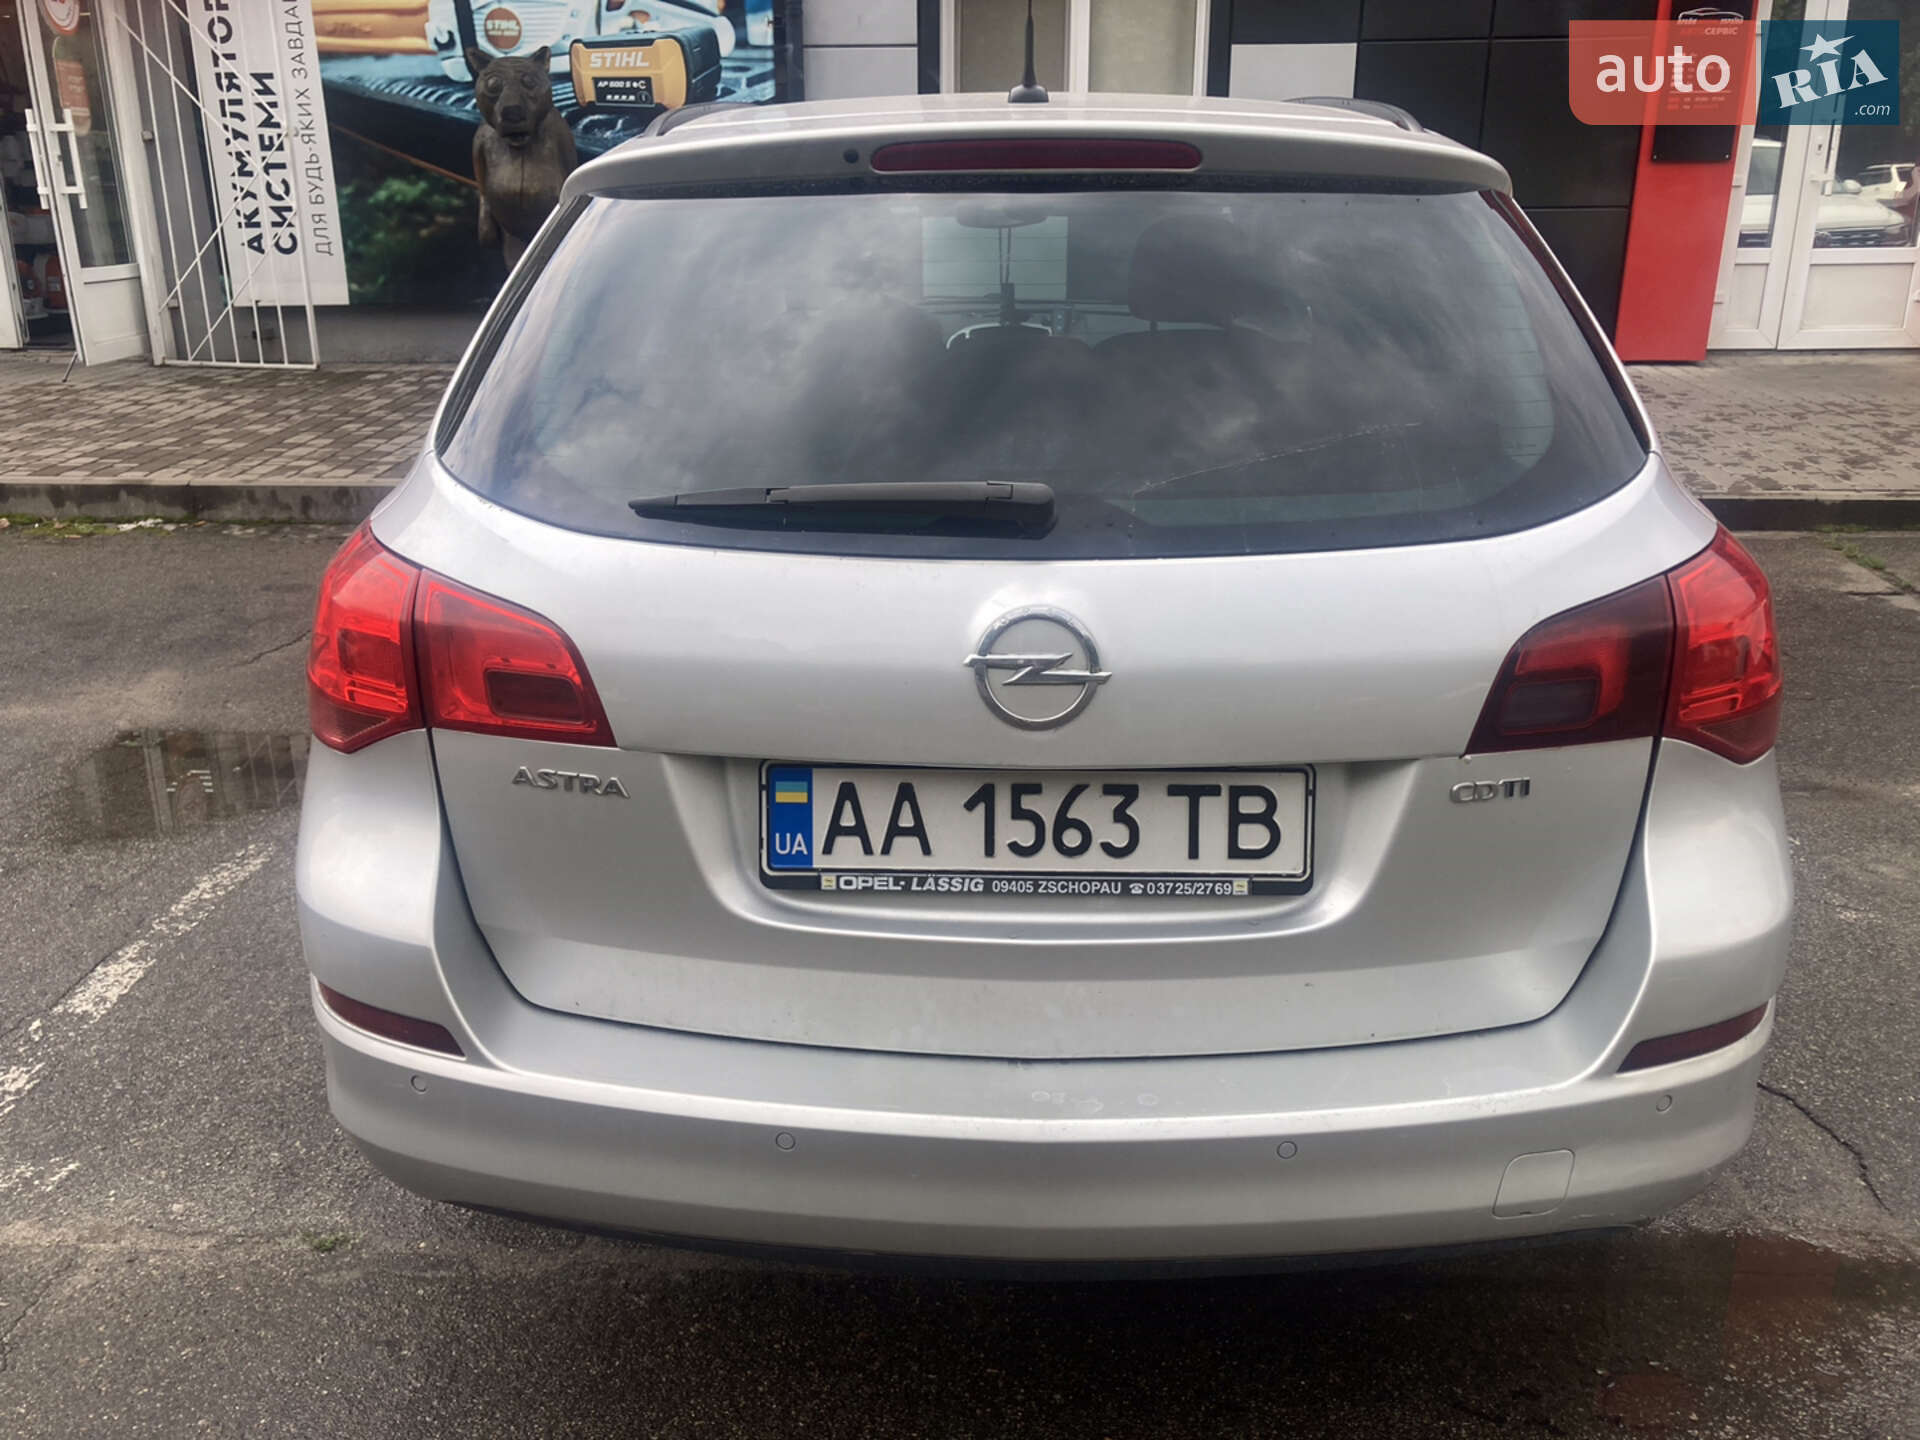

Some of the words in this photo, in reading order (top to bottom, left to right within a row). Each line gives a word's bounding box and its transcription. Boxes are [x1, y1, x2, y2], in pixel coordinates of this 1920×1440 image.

[283, 0, 308, 79] ЗАВДА
[589, 51, 649, 68] STIHL
[249, 72, 298, 255] СИСТЕМИ
[295, 88, 326, 205] БУДЬ-ЯКИХ
[311, 213, 333, 256] ДЛЯ
[512, 766, 631, 800] ASTRA
[1450, 777, 1530, 804] CDTI
[822, 781, 933, 856] AA
[963, 783, 1141, 859] 1563
[1167, 784, 1282, 860] TB
[775, 832, 808, 856] UA
[910, 873, 985, 893] LÄSSIG
[991, 879, 1034, 894] 09405
[1038, 880, 1122, 895] ZSCHOPAU
[1146, 882, 1233, 896] 03725/2769
